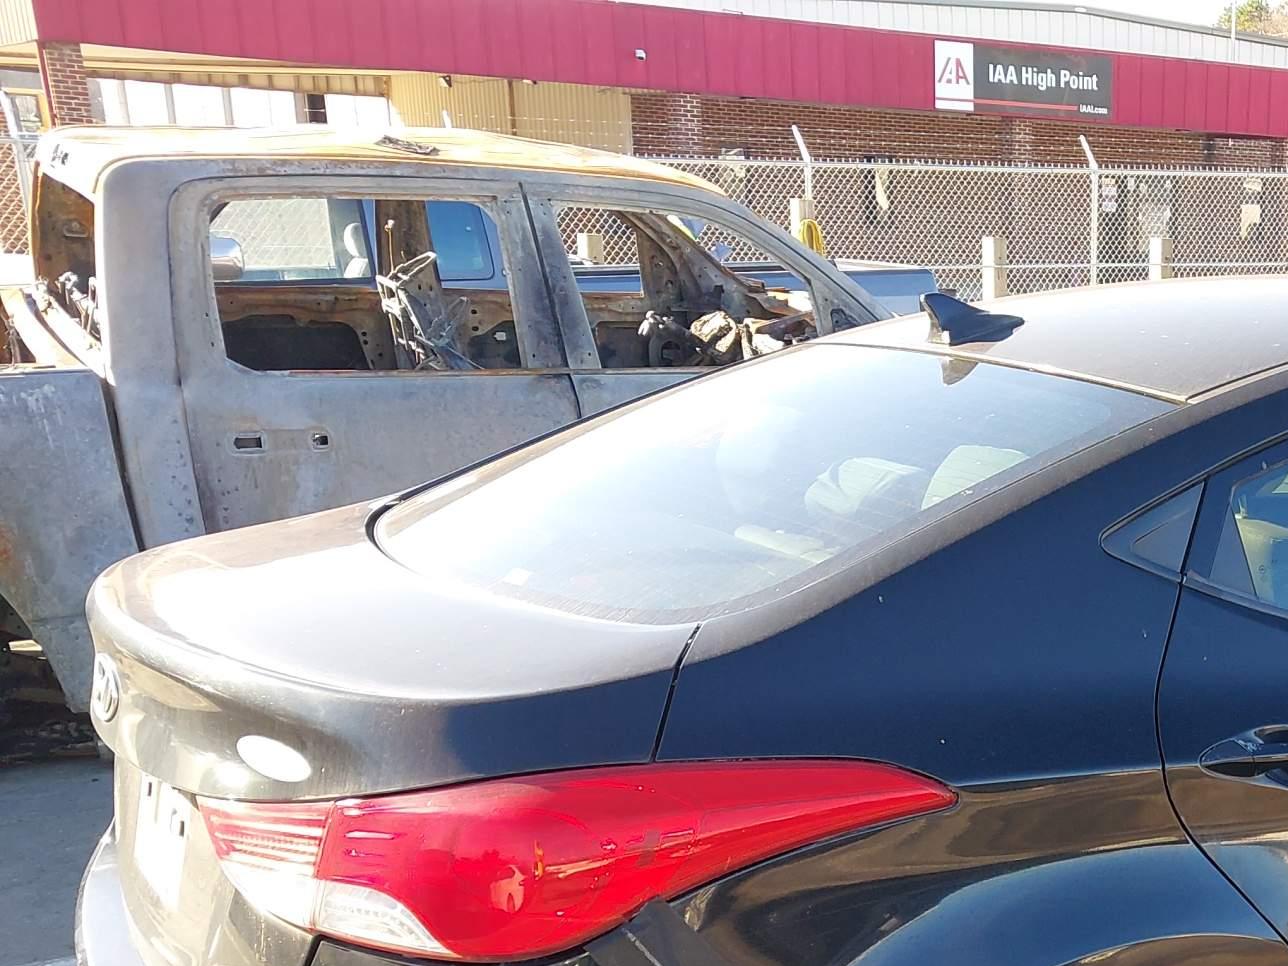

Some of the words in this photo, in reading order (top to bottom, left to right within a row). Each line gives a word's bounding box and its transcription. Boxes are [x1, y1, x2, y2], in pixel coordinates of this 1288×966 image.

[988, 63, 1018, 85] IAA
[1021, 66, 1056, 91] High
[1060, 69, 1099, 90] Point
